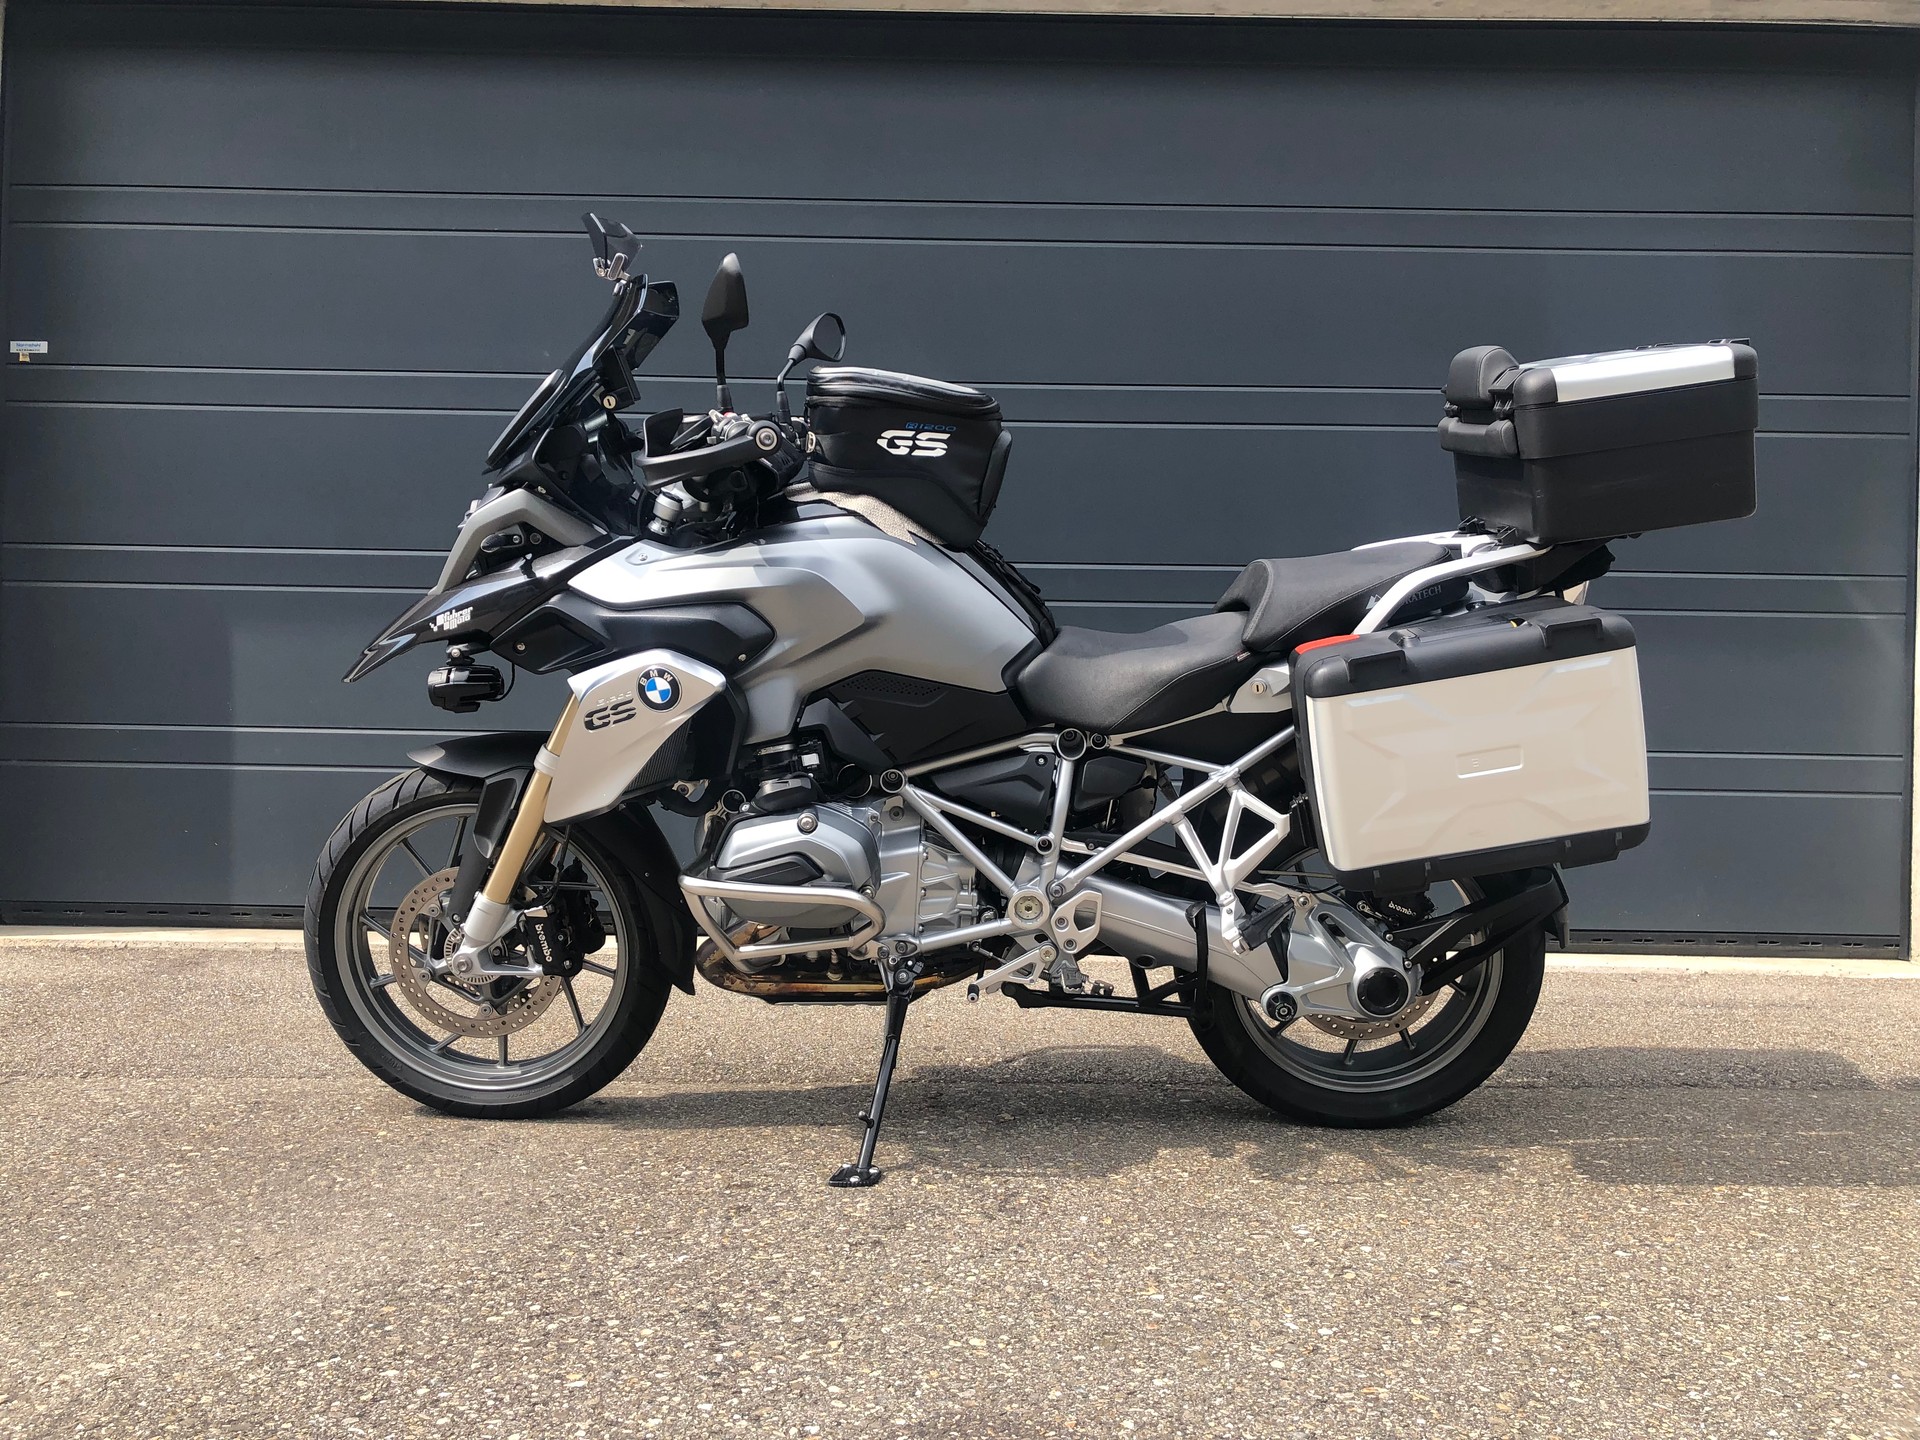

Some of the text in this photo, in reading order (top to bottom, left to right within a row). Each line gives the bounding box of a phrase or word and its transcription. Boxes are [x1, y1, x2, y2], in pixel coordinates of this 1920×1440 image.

[876, 429, 951, 457] GS
[1403, 584, 1442, 605] RATECH
[639, 669, 674, 687] BMW
[584, 698, 637, 732] GS
[1388, 900, 1417, 917] brembo
[534, 923, 553, 962] brembo
